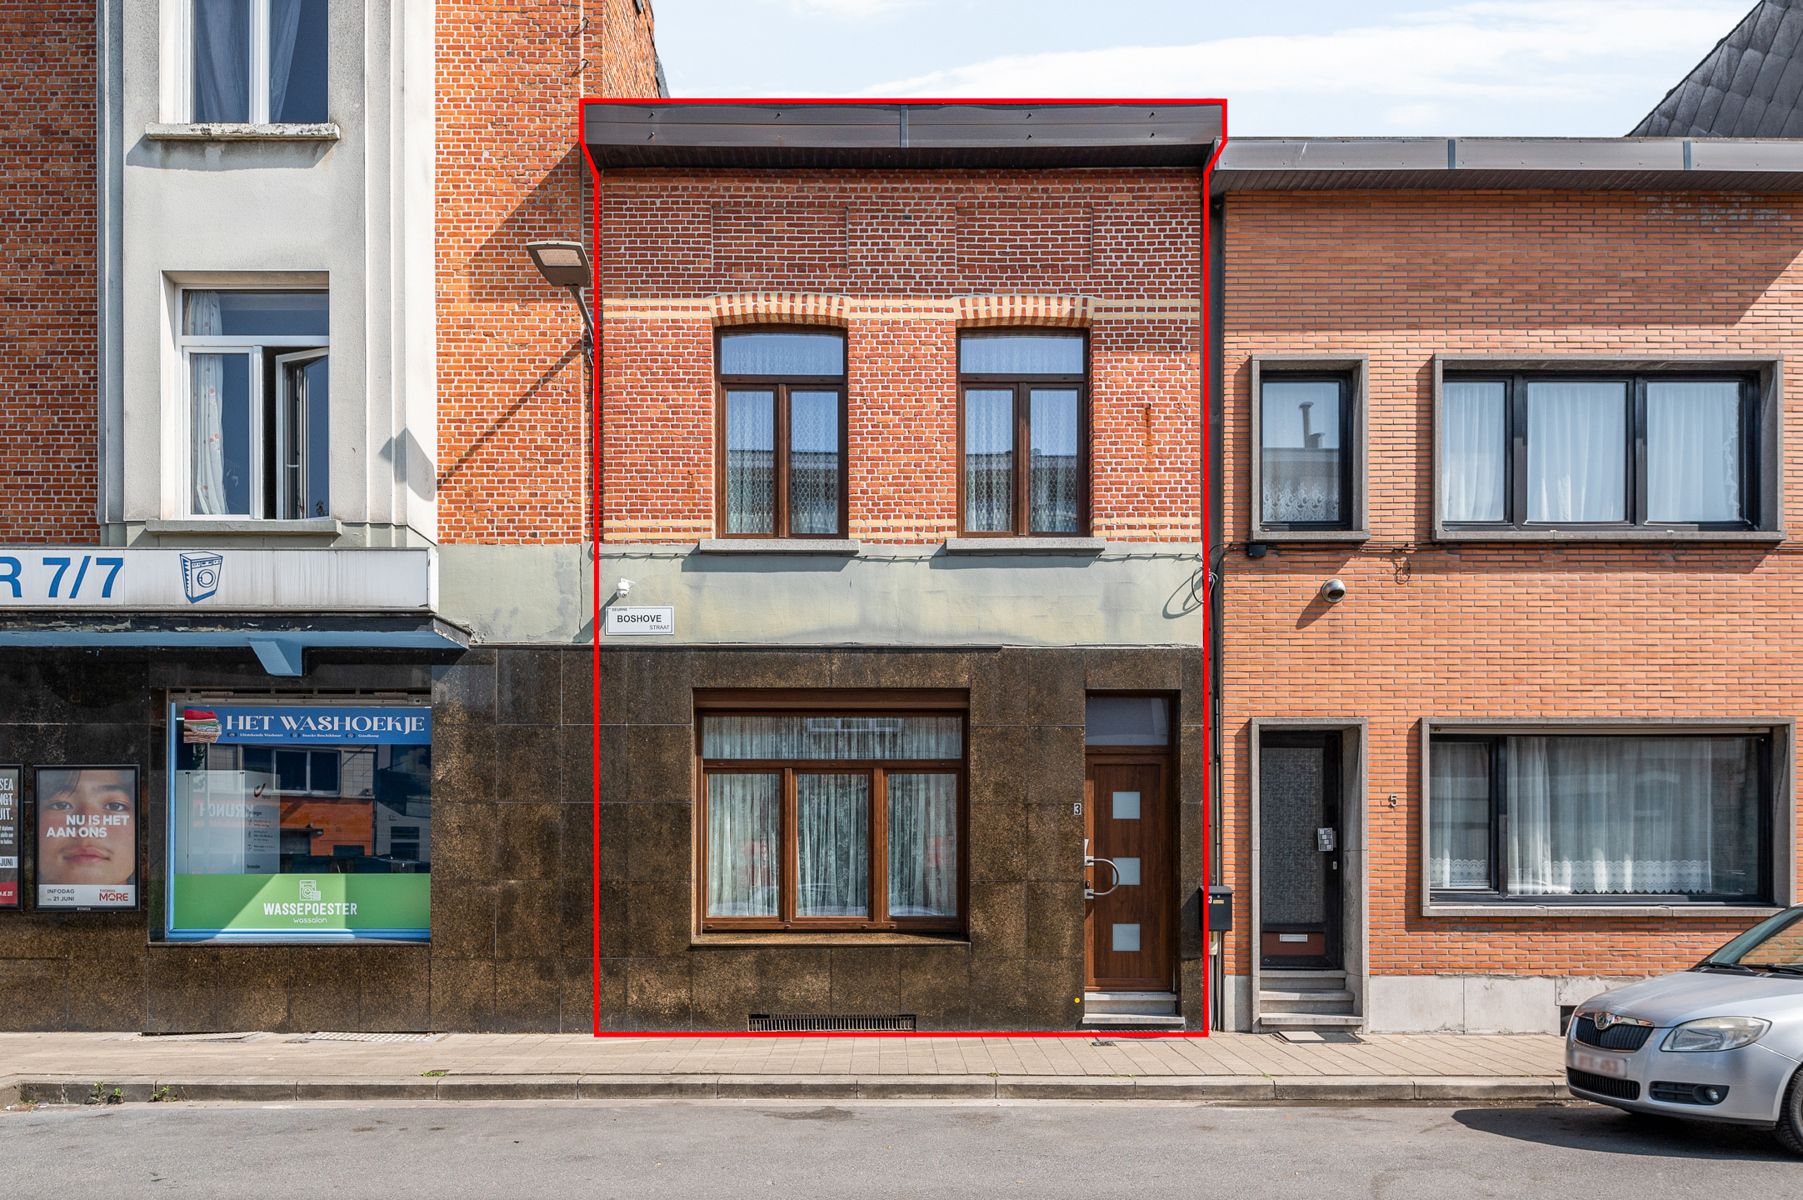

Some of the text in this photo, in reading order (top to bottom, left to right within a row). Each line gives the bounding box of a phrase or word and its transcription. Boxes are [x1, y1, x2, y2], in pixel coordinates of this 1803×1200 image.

[0, 556, 124, 599] R 7/7
[227, 715, 425, 735] HET WASHOEKJE
[1391, 794, 1398, 806] 5
[1074, 803, 1081, 815] 3
[66, 815, 129, 825] NU IS HET
[46, 827, 107, 838] AAN ONS
[99, 893, 128, 901] MORE
[263, 903, 357, 915] WASSEPOESTER
